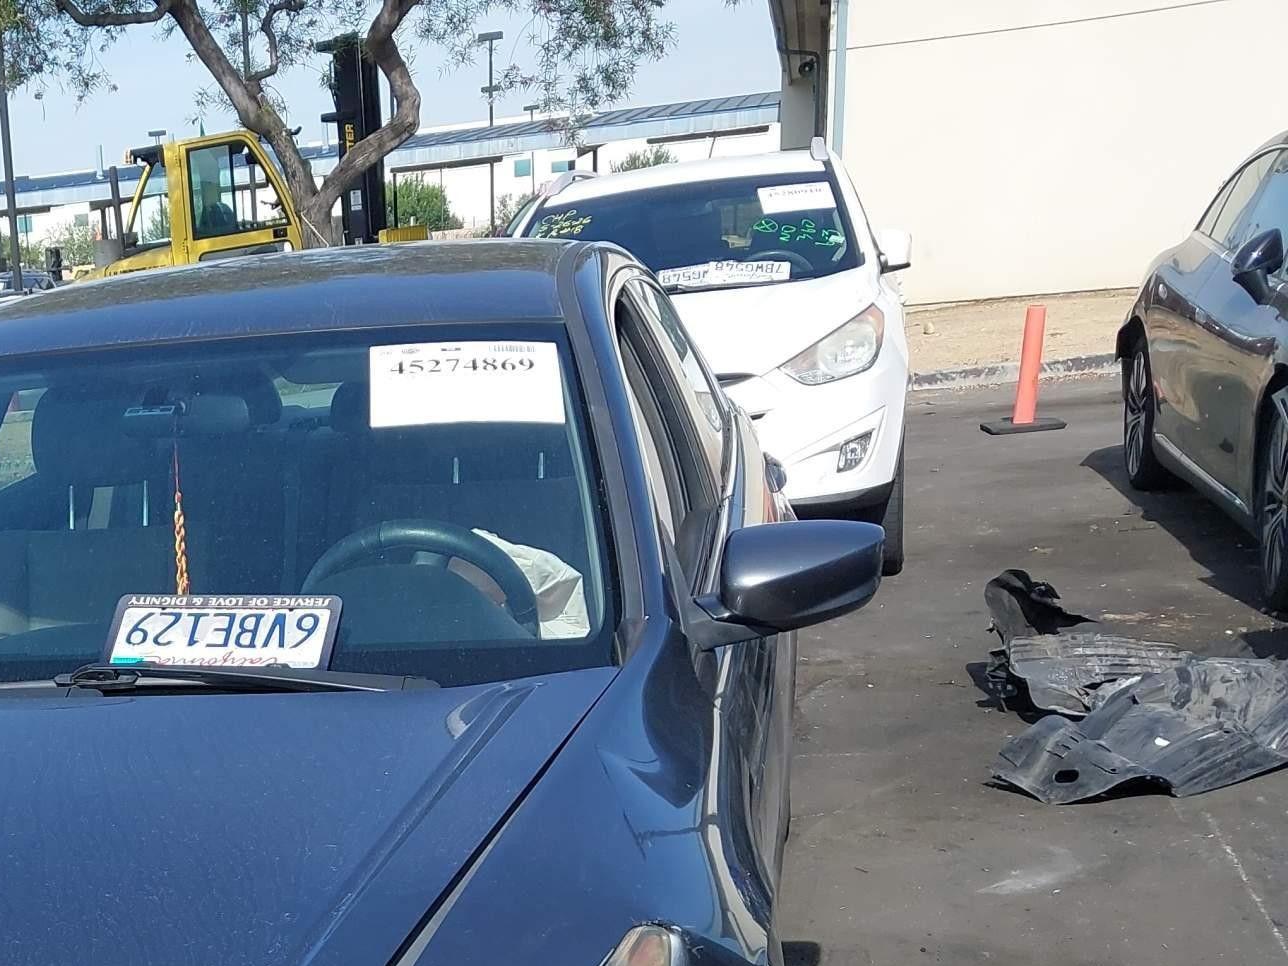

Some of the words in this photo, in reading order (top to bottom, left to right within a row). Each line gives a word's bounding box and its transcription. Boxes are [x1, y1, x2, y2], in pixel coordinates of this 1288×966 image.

[715, 262, 784, 273] 7BWG548
[390, 357, 535, 374] 45274869
[128, 596, 183, 605] DIGNITY
[208, 597, 242, 606] LOVE
[248, 597, 268, 605] OF
[273, 597, 332, 607] SERVICE
[125, 612, 320, 649] 6VBE129
